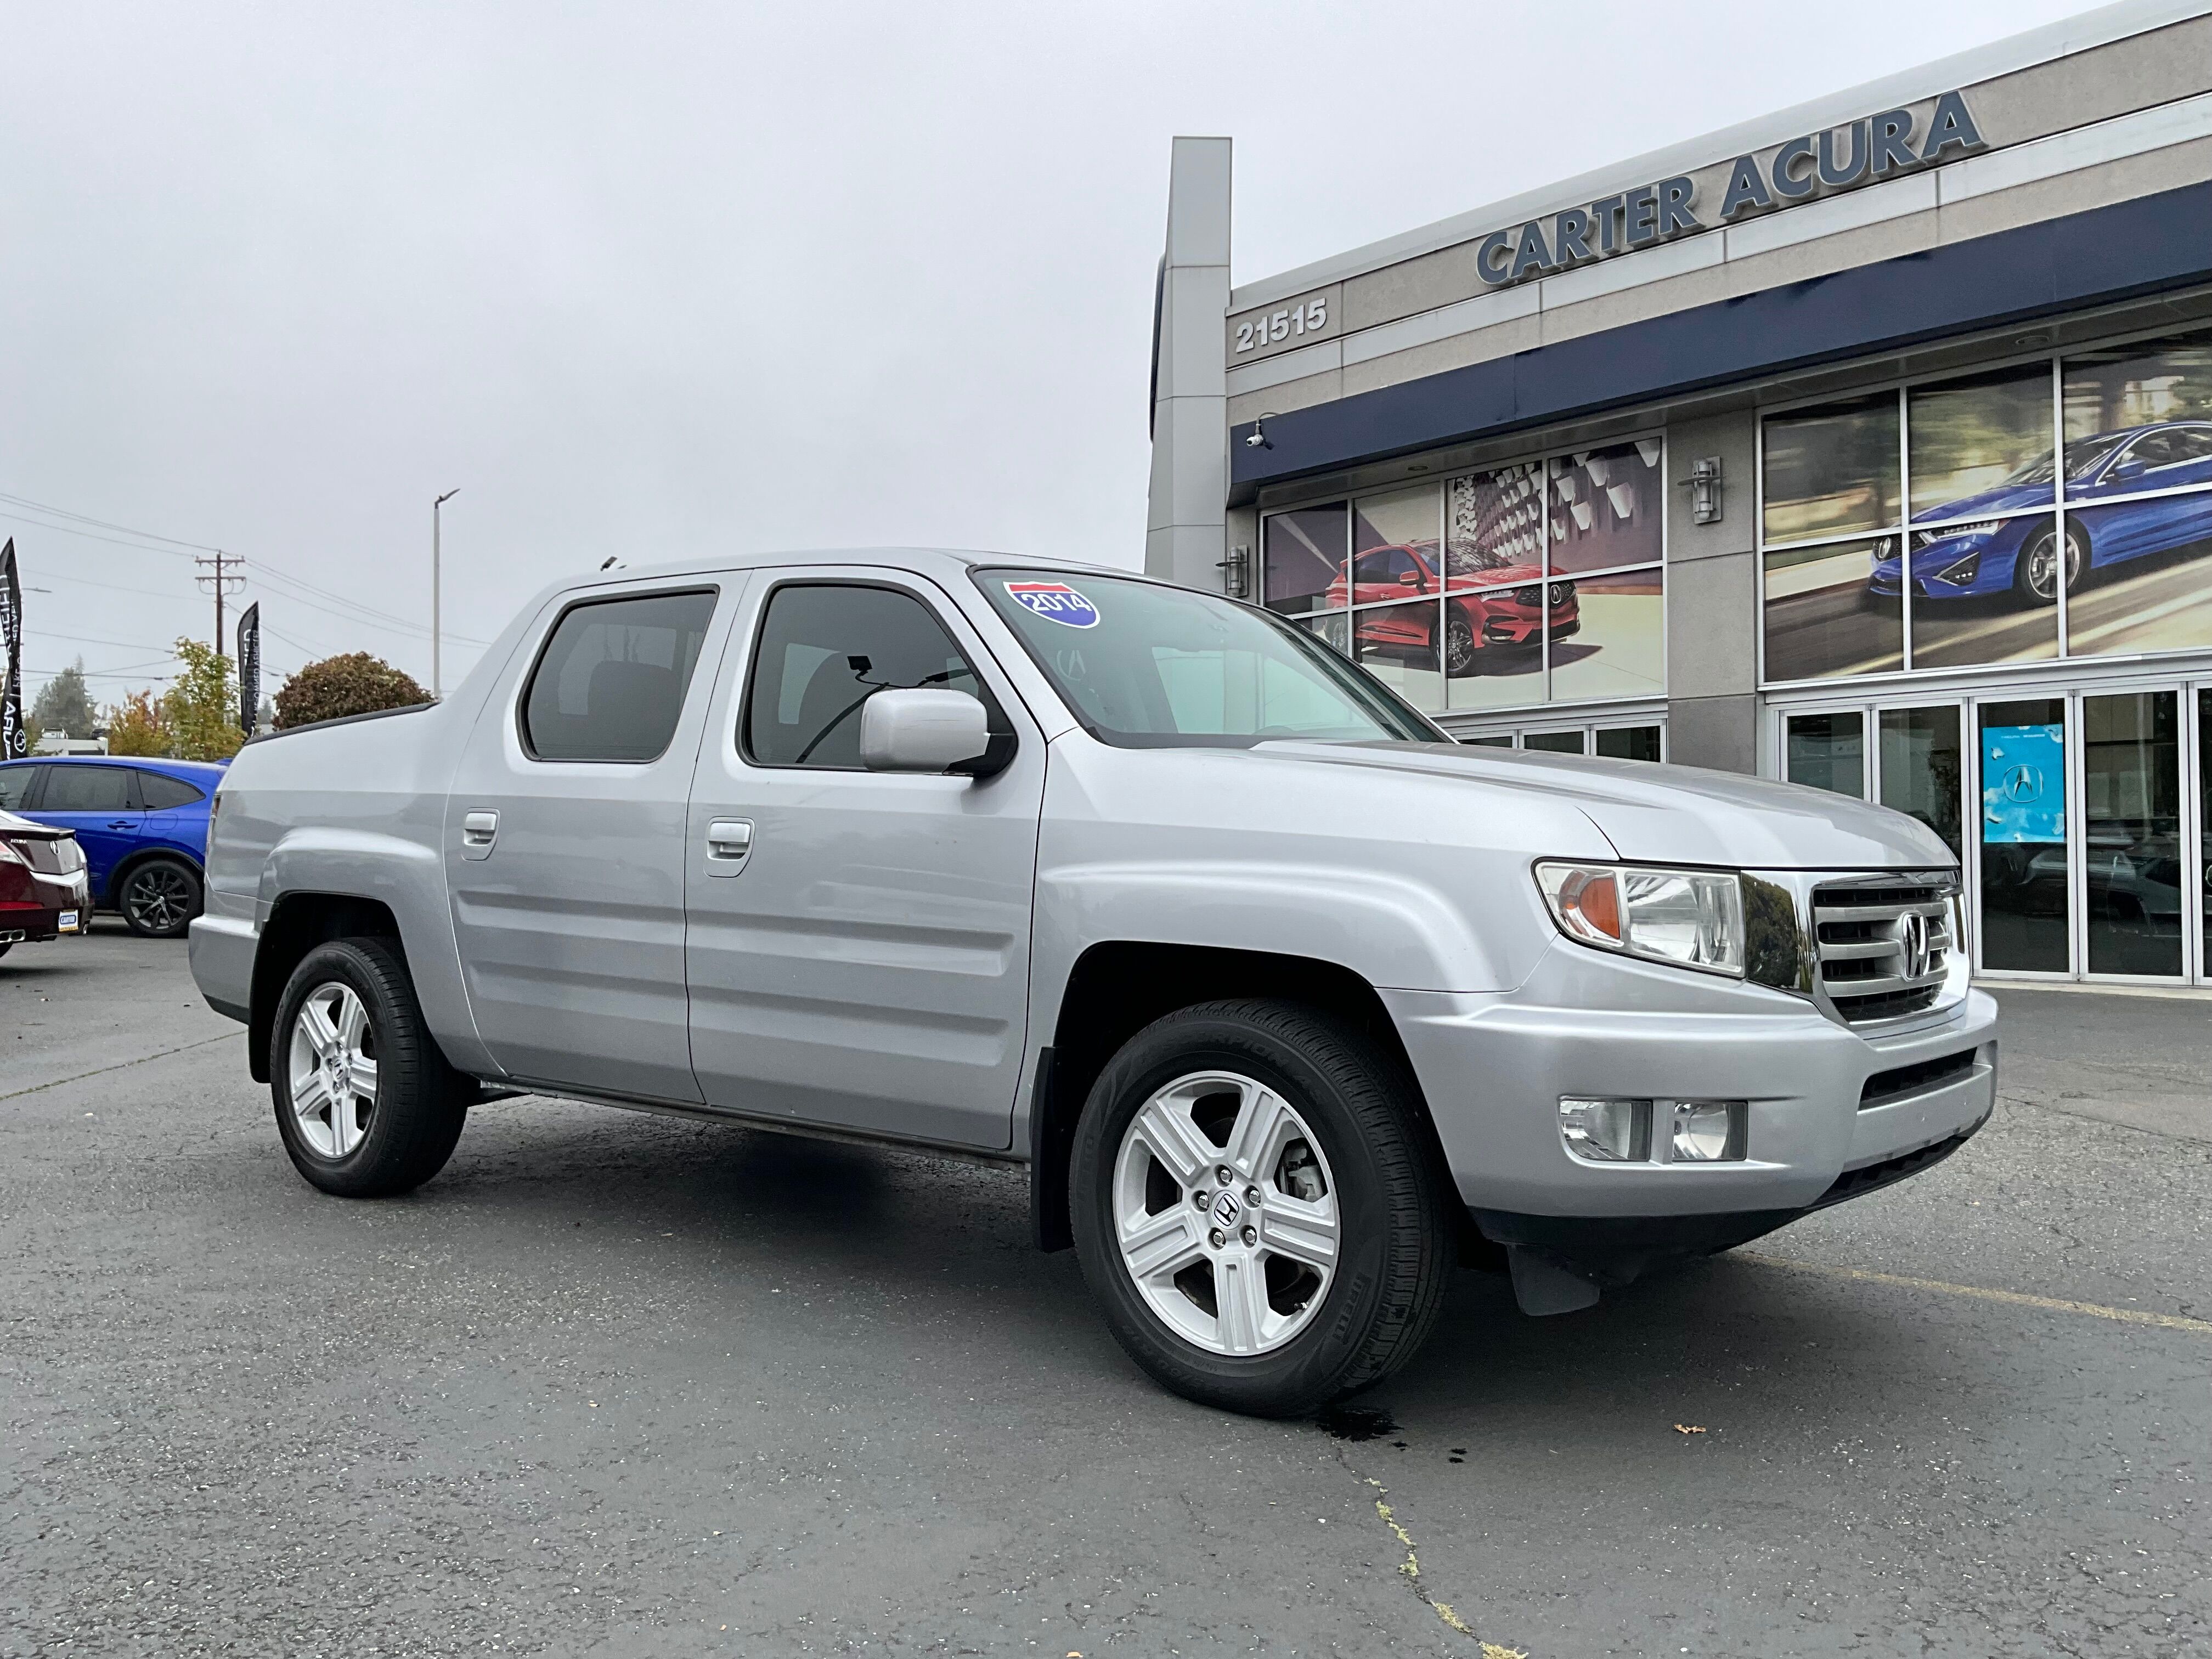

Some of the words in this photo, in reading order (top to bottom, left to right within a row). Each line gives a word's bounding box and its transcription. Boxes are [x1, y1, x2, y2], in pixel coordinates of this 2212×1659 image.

[1476, 176, 1700, 285] CARTER
[1719, 89, 1983, 218] ACURA
[1235, 297, 1327, 353] 21515
[1021, 593, 1093, 612] 2014
